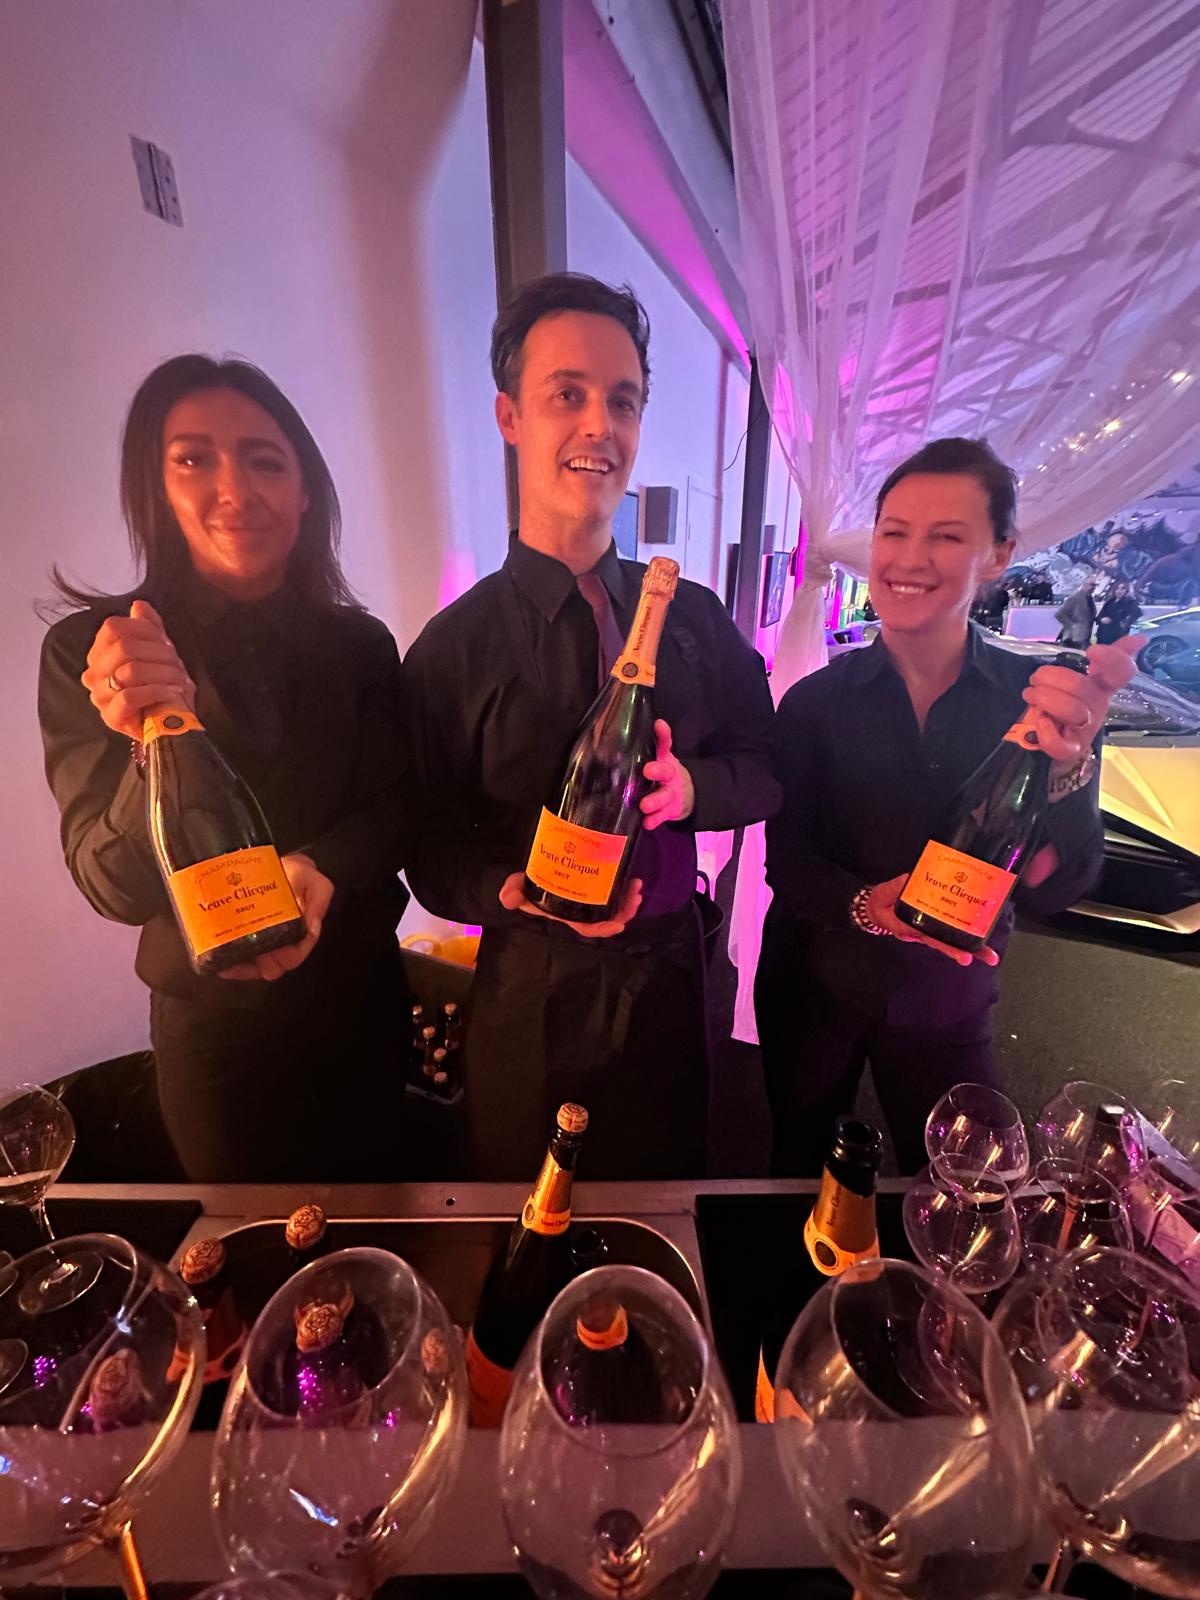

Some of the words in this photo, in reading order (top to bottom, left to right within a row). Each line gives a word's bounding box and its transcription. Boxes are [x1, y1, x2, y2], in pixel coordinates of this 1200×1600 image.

[540, 842, 559, 863] Veuve
[561, 855, 600, 876] Clicquot
[198, 895, 233, 913] Veuve
[233, 880, 277, 901] Clicquot
[925, 871, 948, 890] Veuve
[949, 884, 987, 907] Clicquot
